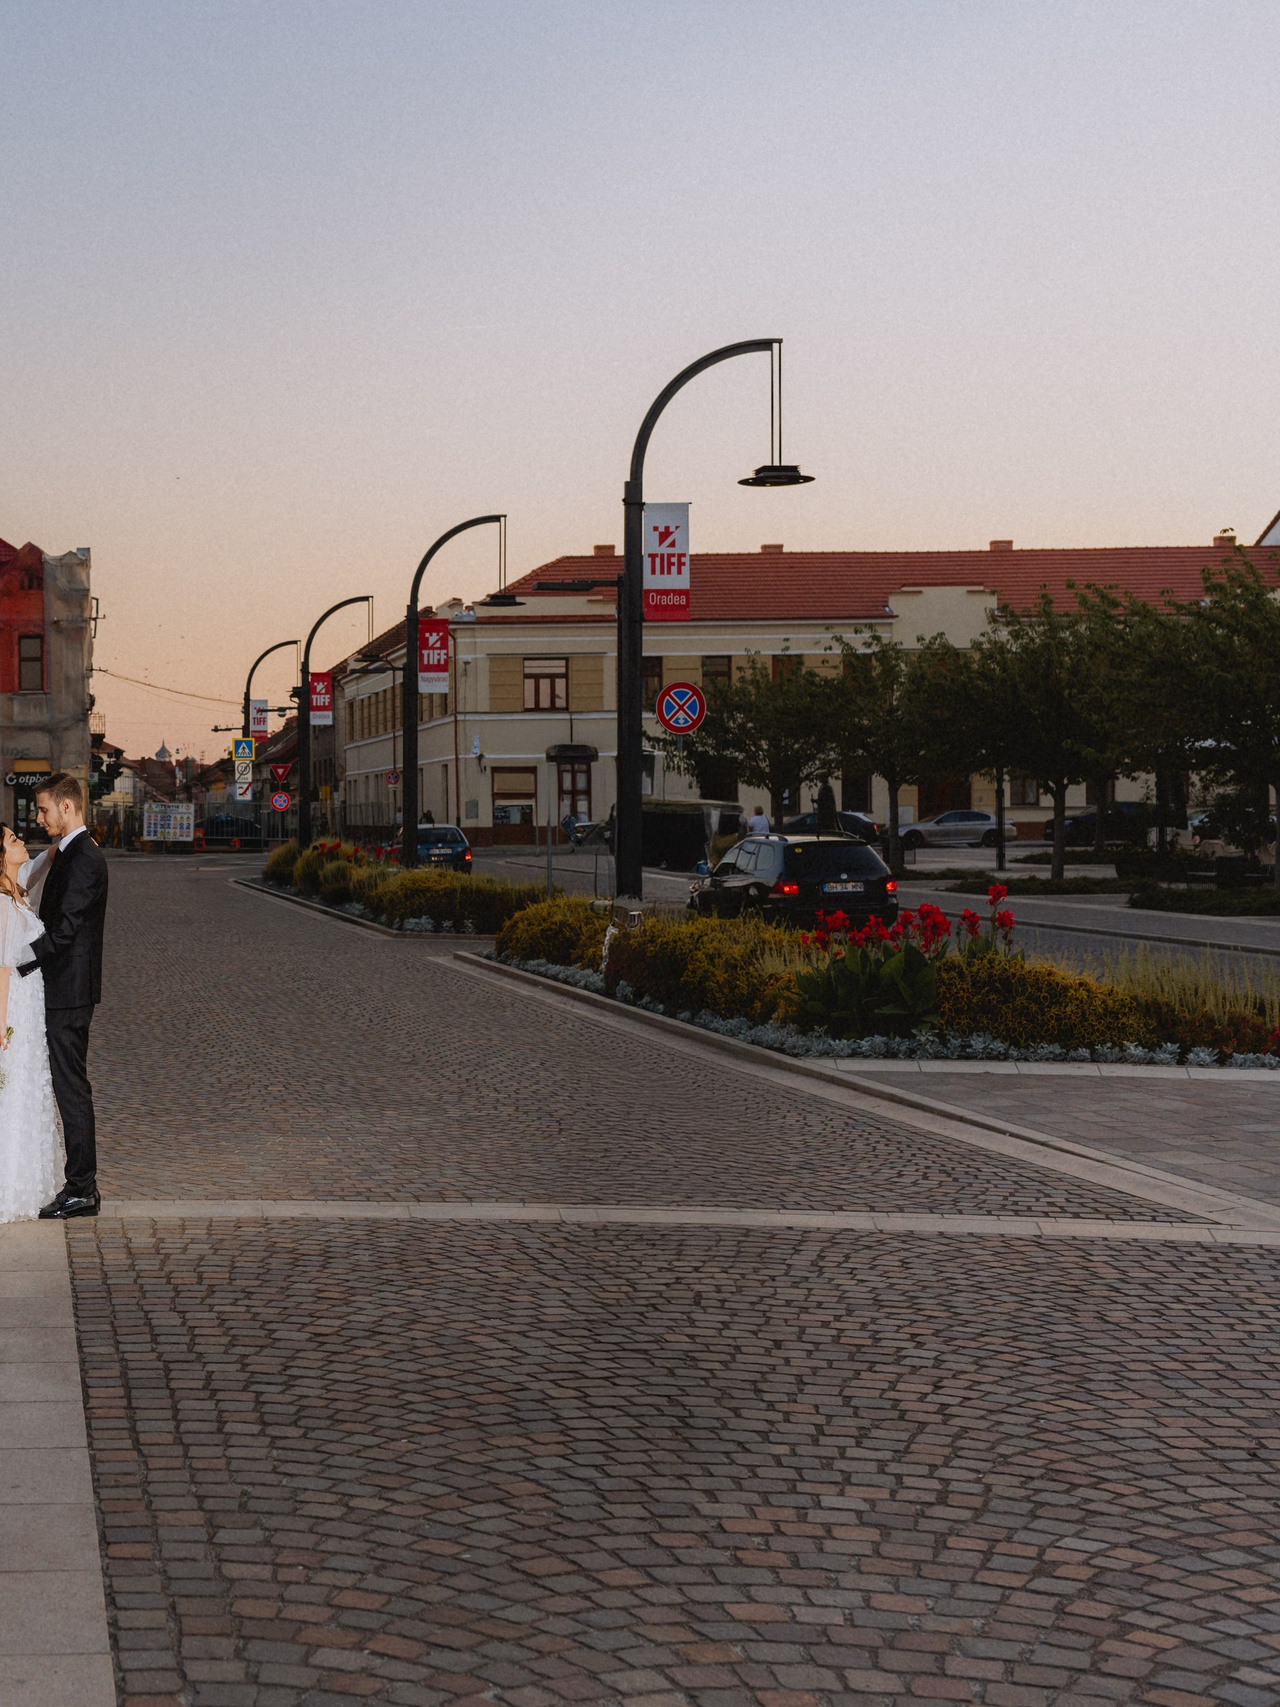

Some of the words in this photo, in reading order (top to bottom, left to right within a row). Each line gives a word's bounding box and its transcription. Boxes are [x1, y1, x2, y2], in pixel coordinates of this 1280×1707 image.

[647, 552, 687, 576] TIFF
[649, 592, 687, 605] Oradea
[421, 649, 448, 665] TIFF
[311, 694, 331, 706] TIFF
[252, 717, 267, 725] TIFF
